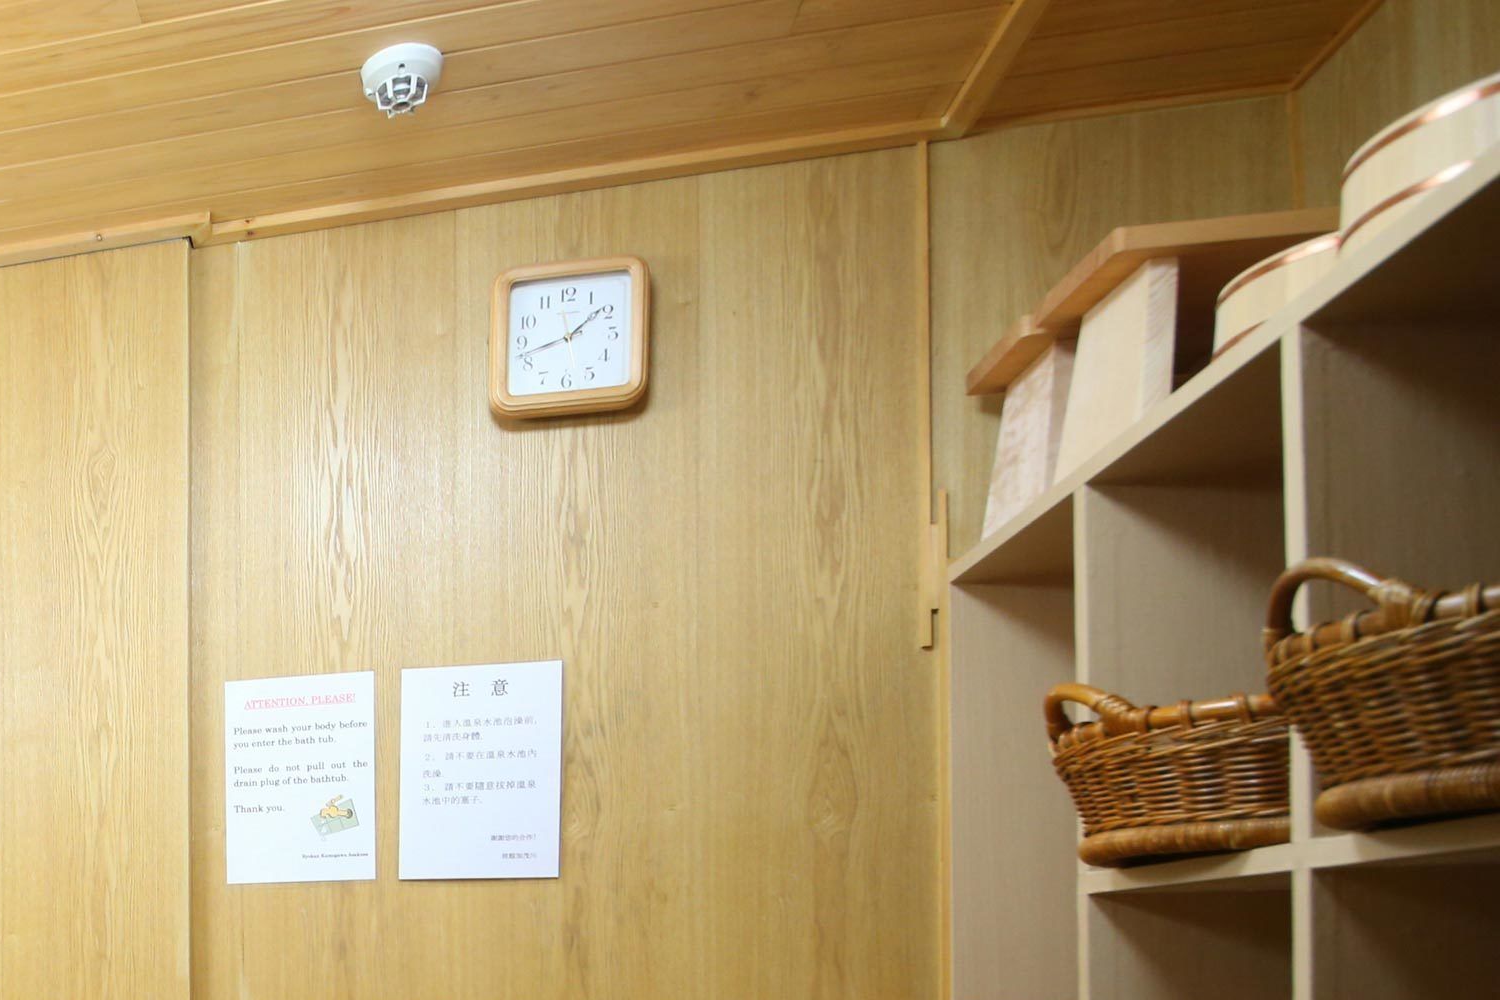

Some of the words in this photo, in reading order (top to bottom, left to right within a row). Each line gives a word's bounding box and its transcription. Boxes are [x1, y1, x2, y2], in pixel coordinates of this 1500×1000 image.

[561, 287, 577, 302] 12
[589, 292, 593, 304] 1
[540, 296, 551, 309] 11
[602, 304, 614, 319] 2
[521, 315, 536, 329] 10
[608, 326, 618, 341] 3
[517, 336, 528, 350] 9
[598, 349, 610, 362] 4
[523, 356, 533, 371] 8
[538, 371, 549, 385] 7
[561, 370, 572, 388] 6
[584, 367, 595, 381] 5
[244, 695, 309, 710] ATTENTION,
[312, 693, 356, 706] PLEASE!
[233, 727, 262, 735] Please
[265, 725, 288, 733] wash
[291, 725, 312, 733] your
[315, 722, 336, 730] body
[339, 720, 368, 728] before
[233, 741, 249, 749] you
[251, 739, 275, 747] enter
[277, 738, 293, 746] the
[295, 736, 316, 744] bath
[318, 735, 337, 743] tub.
[234, 766, 262, 774] Please
[268, 764, 279, 772] do
[307, 762, 325, 771] pull
[352, 760, 368, 768] the
[233, 779, 258, 787] drain
[260, 777, 280, 787] plug
[282, 777, 293, 785] of
[310, 774, 349, 783] bathtub.
[233, 804, 264, 813] Thank
[266, 805, 285, 813] you.
